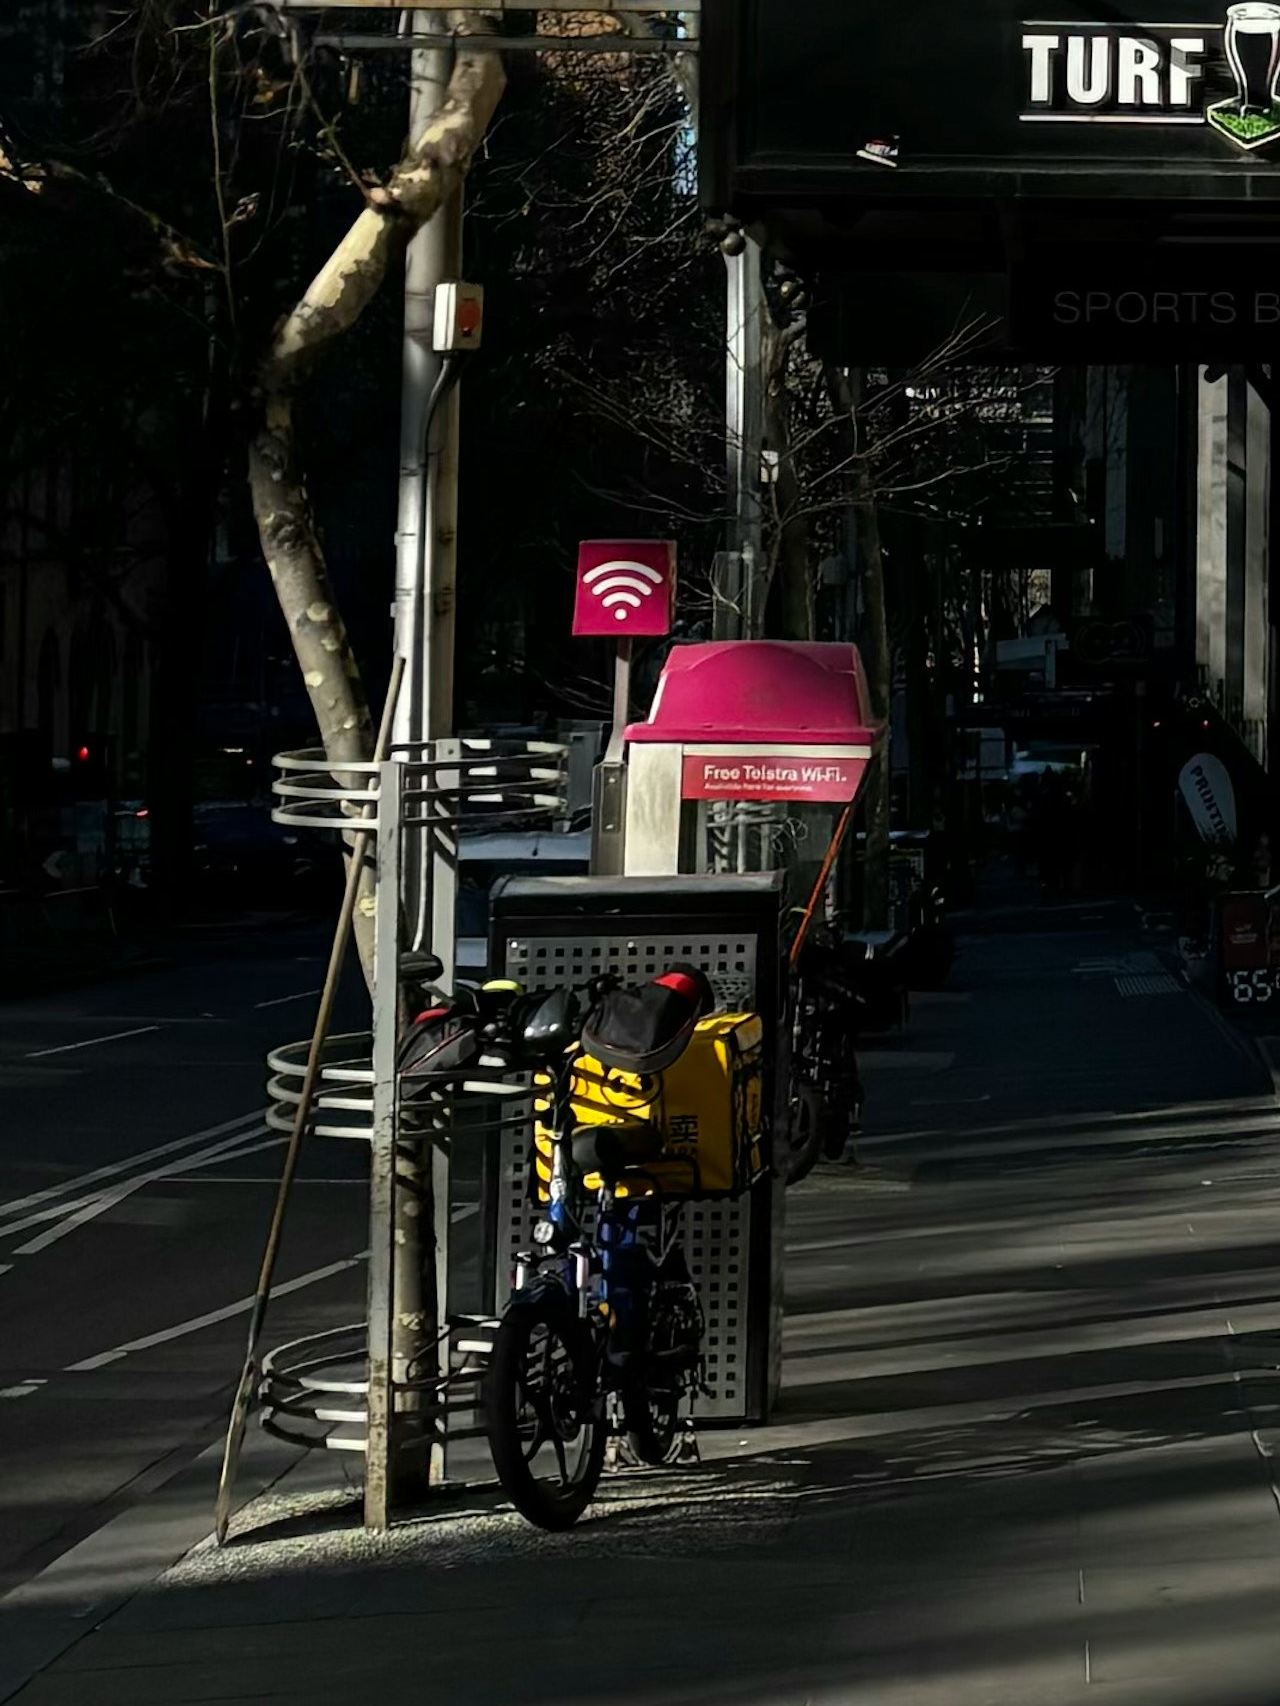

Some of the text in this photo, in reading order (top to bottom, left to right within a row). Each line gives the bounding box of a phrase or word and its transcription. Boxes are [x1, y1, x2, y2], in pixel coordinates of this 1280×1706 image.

[1021, 34, 1205, 105] TURF
[1052, 290, 1238, 325] SPORTS
[703, 764, 741, 780] Free
[742, 764, 797, 781] Telstra
